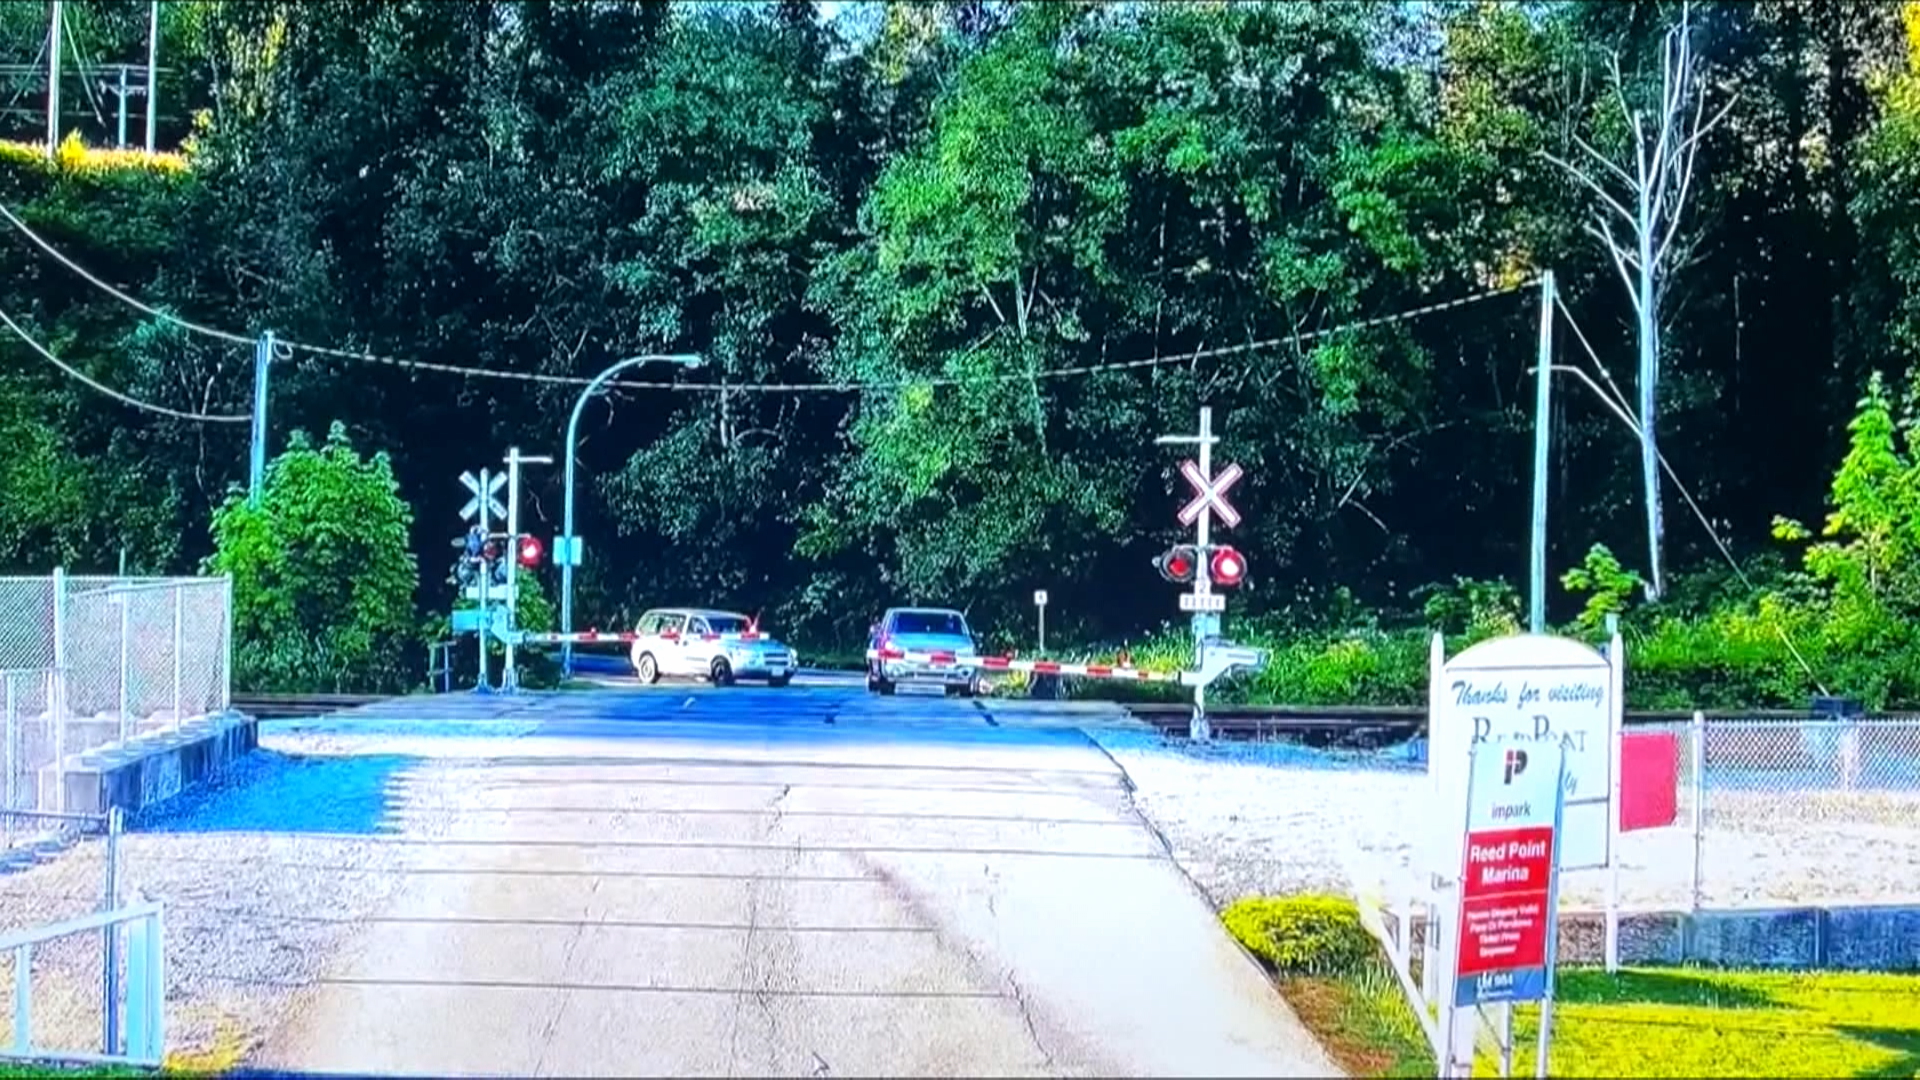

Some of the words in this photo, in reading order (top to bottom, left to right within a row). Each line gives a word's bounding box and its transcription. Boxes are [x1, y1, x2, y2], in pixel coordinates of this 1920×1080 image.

[1451, 680, 1508, 706] Thanks
[1517, 681, 1541, 710] for
[1548, 683, 1605, 708] visiting
[1491, 801, 1531, 820] impark
[1470, 842, 1507, 863] Reed
[1508, 839, 1547, 860] Point
[1482, 865, 1530, 887] Marina
